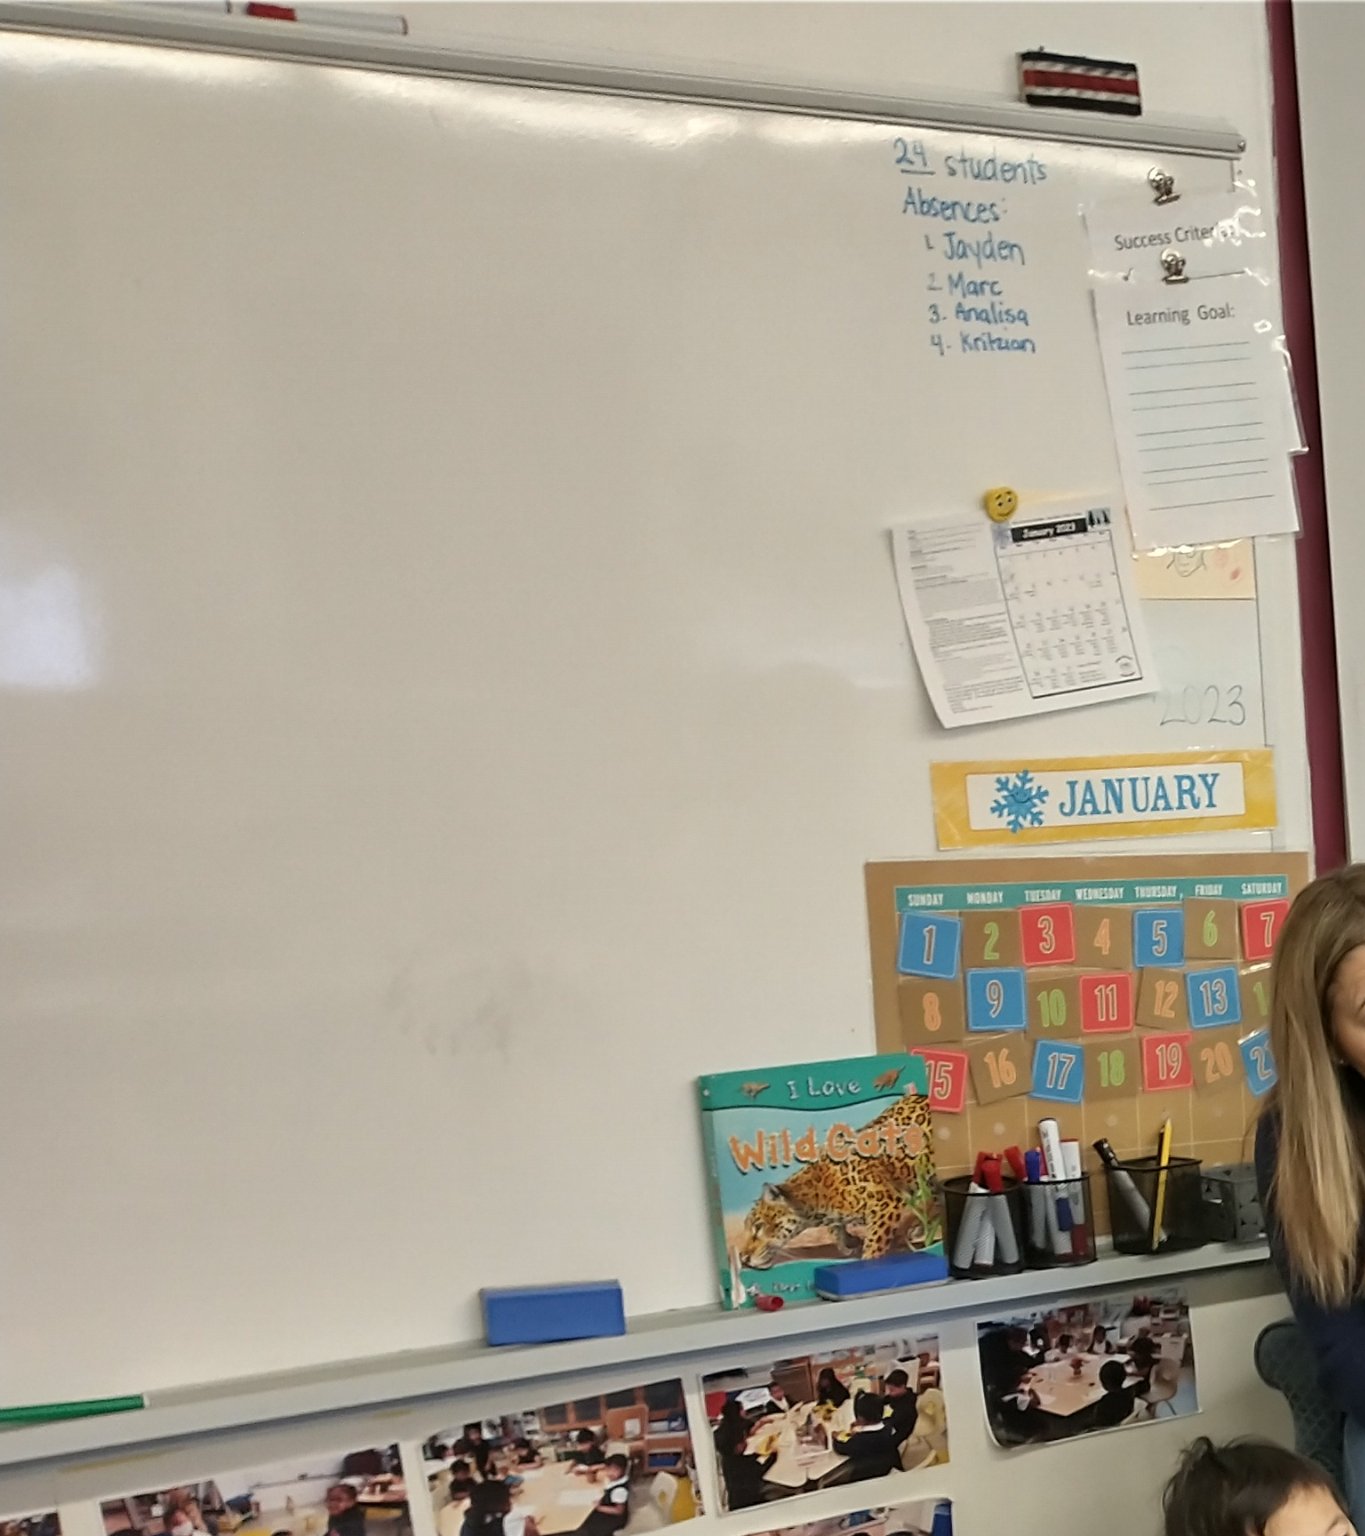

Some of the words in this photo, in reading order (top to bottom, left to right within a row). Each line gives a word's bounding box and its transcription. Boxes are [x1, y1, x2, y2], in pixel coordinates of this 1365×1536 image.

[894, 138, 930, 167] 24
[945, 152, 1047, 184] students
[902, 187, 1008, 223] Absences:
[943, 234, 1025, 266] Jayden
[1114, 234, 1172, 251] Success
[948, 273, 1002, 297] Marc
[955, 305, 1030, 327] Analisa
[1126, 309, 1191, 326] Learning
[1197, 303, 1236, 320] Goal:
[1160, 684, 1247, 727] 2023
[1059, 772, 1221, 817] JANUARY
[908, 893, 943, 906] SUNDAY
[966, 891, 1003, 905] MONDAY
[1024, 889, 1062, 902] TUESDAY
[1076, 886, 1124, 900] WEDNESDAY
[1134, 885, 1178, 899] THURSDAY
[1194, 883, 1224, 896] FRIDAY
[1240, 881, 1282, 895] SATURDAY
[922, 925, 938, 965] 1
[983, 921, 1000, 961] 2
[1038, 914, 1056, 955] 3
[1093, 917, 1111, 956] 4
[1151, 919, 1169, 957] 5
[1203, 909, 1219, 948] 6
[1259, 910, 1277, 948] 7
[922, 991, 942, 1032] 8
[986, 979, 1004, 1019] 9
[1036, 988, 1067, 1028] 10
[1094, 983, 1119, 1022] 11
[1153, 979, 1180, 1019] 12
[1199, 977, 1229, 1017] 13
[926, 1059, 953, 1101] 15
[983, 1047, 1017, 1089] 16
[1047, 1050, 1077, 1091] 17
[1098, 1048, 1126, 1088] 18
[1155, 1041, 1183, 1081] 19
[1200, 1040, 1233, 1084] 20
[787, 1079, 801, 1101] I
[807, 1074, 861, 1098] Love
[729, 1123, 821, 1175] Wild
[825, 1121, 927, 1163] Cats
